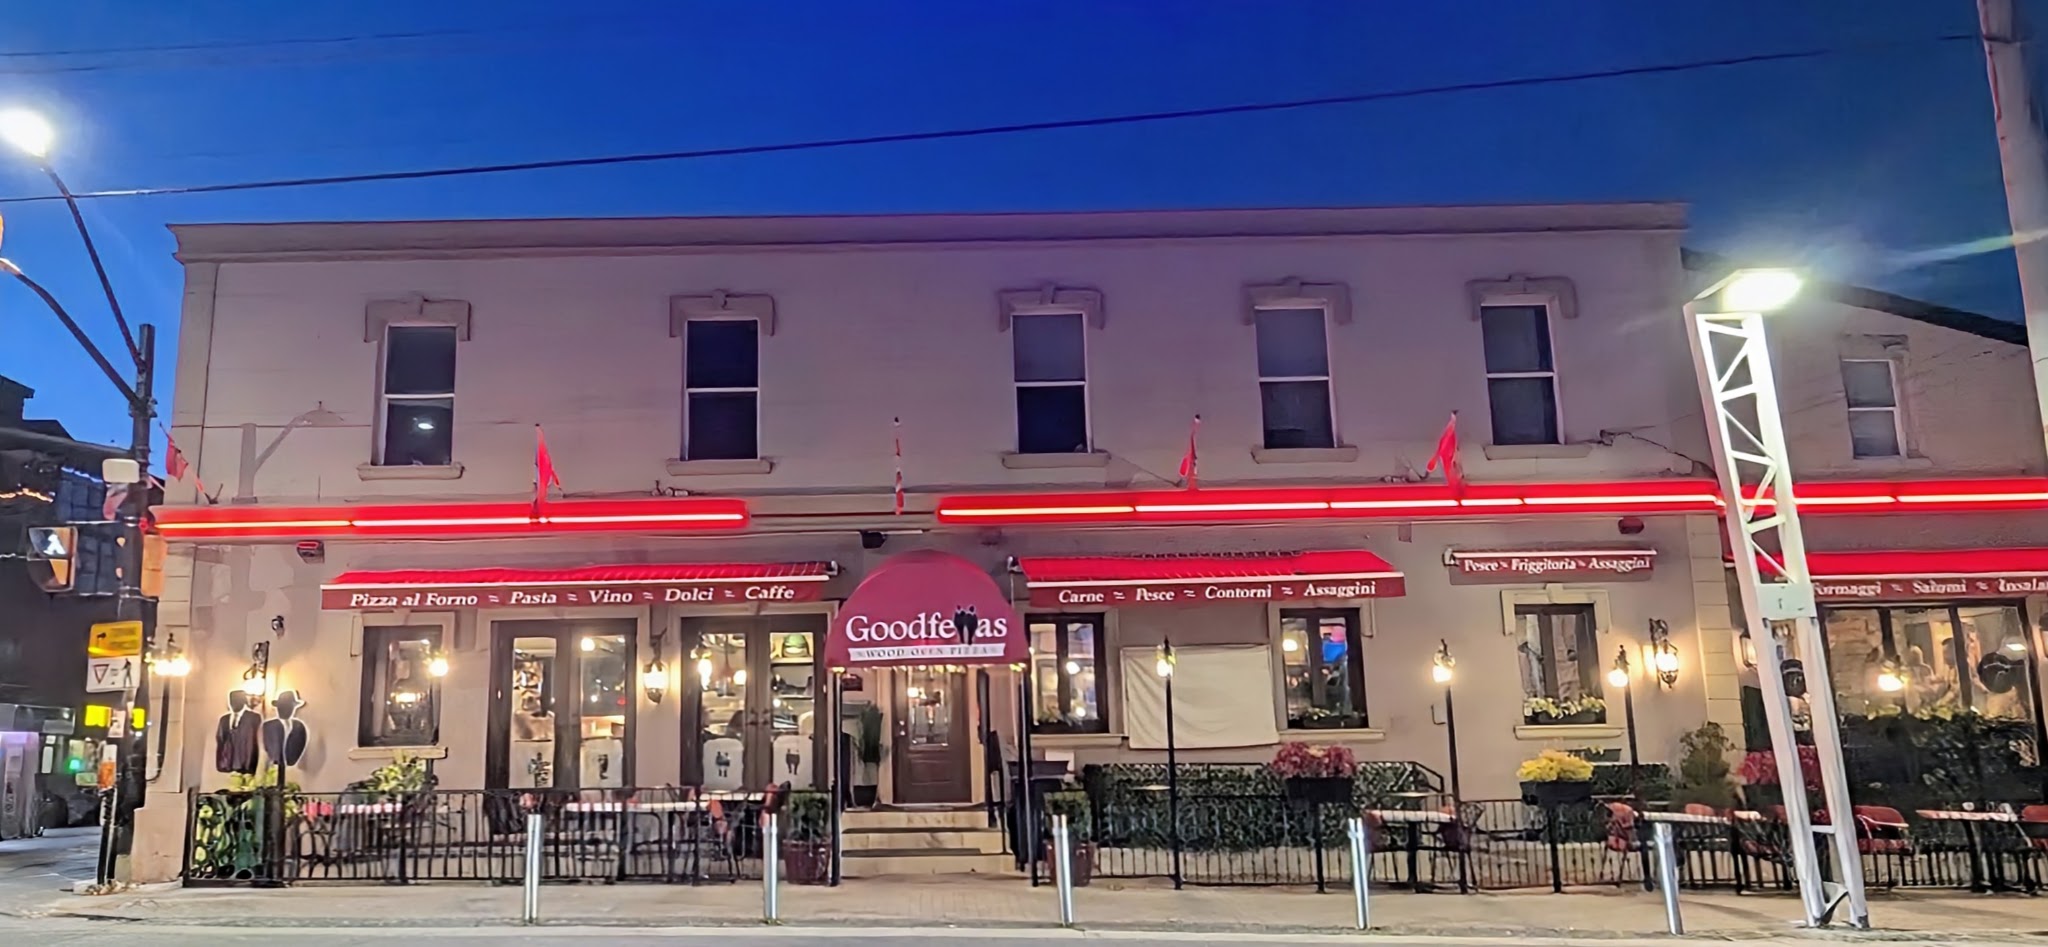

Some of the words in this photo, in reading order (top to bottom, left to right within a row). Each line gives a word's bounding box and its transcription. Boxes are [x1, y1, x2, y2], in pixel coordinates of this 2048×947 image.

[350, 593, 398, 607] Pizza
[401, 592, 419, 606] al
[424, 592, 478, 606] Forno
[509, 590, 557, 605] Pasta
[589, 589, 633, 603] Vino
[664, 587, 714, 602] Dolci
[744, 585, 796, 600] Caffe
[1058, 589, 1105, 603] Carne
[1136, 587, 1176, 601] Pesce
[1204, 584, 1272, 599] Contorni
[1303, 581, 1376, 597] Assaggini
[1814, 581, 1881, 597] ormaggi
[866, 648, 905, 659] WOOD
[950, 646, 988, 655] PIZZA
